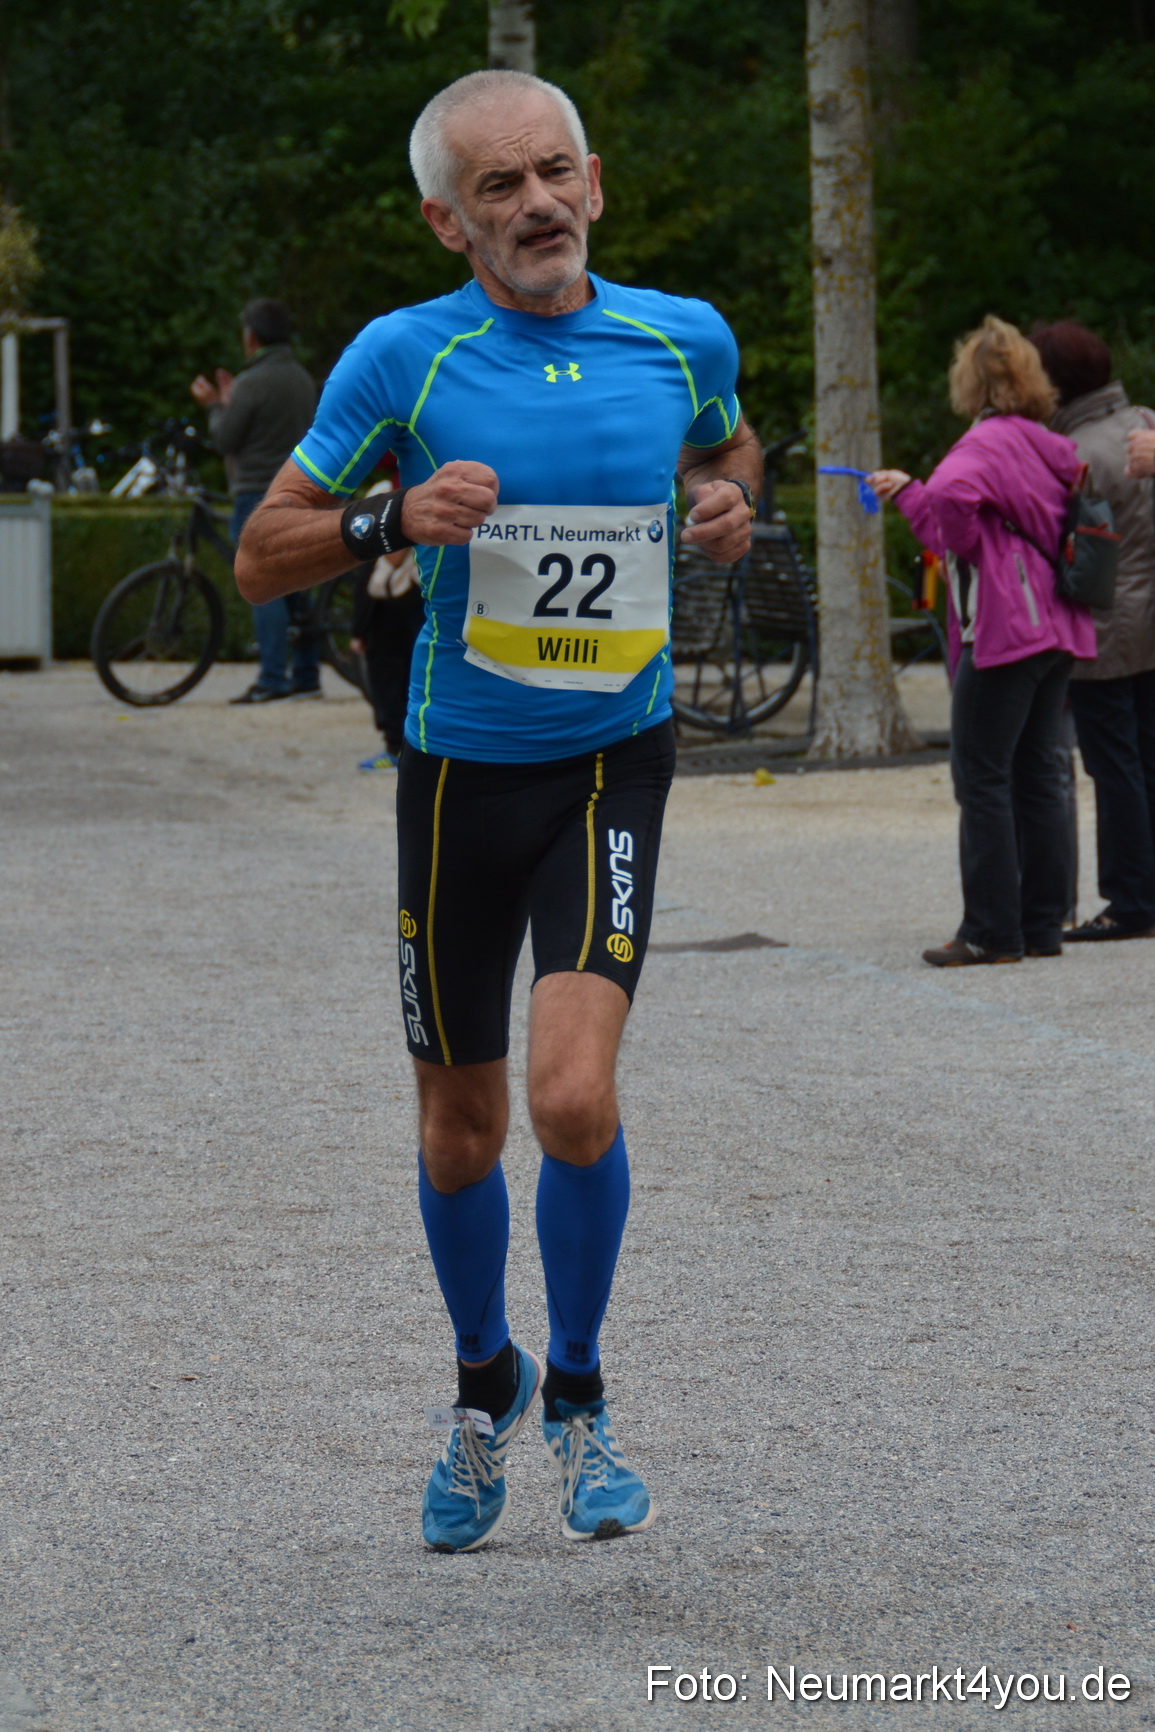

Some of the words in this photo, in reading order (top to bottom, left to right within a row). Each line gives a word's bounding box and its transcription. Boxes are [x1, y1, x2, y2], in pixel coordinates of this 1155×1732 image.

[477, 523, 544, 541] PARTL
[550, 525, 641, 542] Neumarkt
[533, 553, 616, 619] 22
[476, 603, 485, 616] B
[537, 637, 598, 664] Willi
